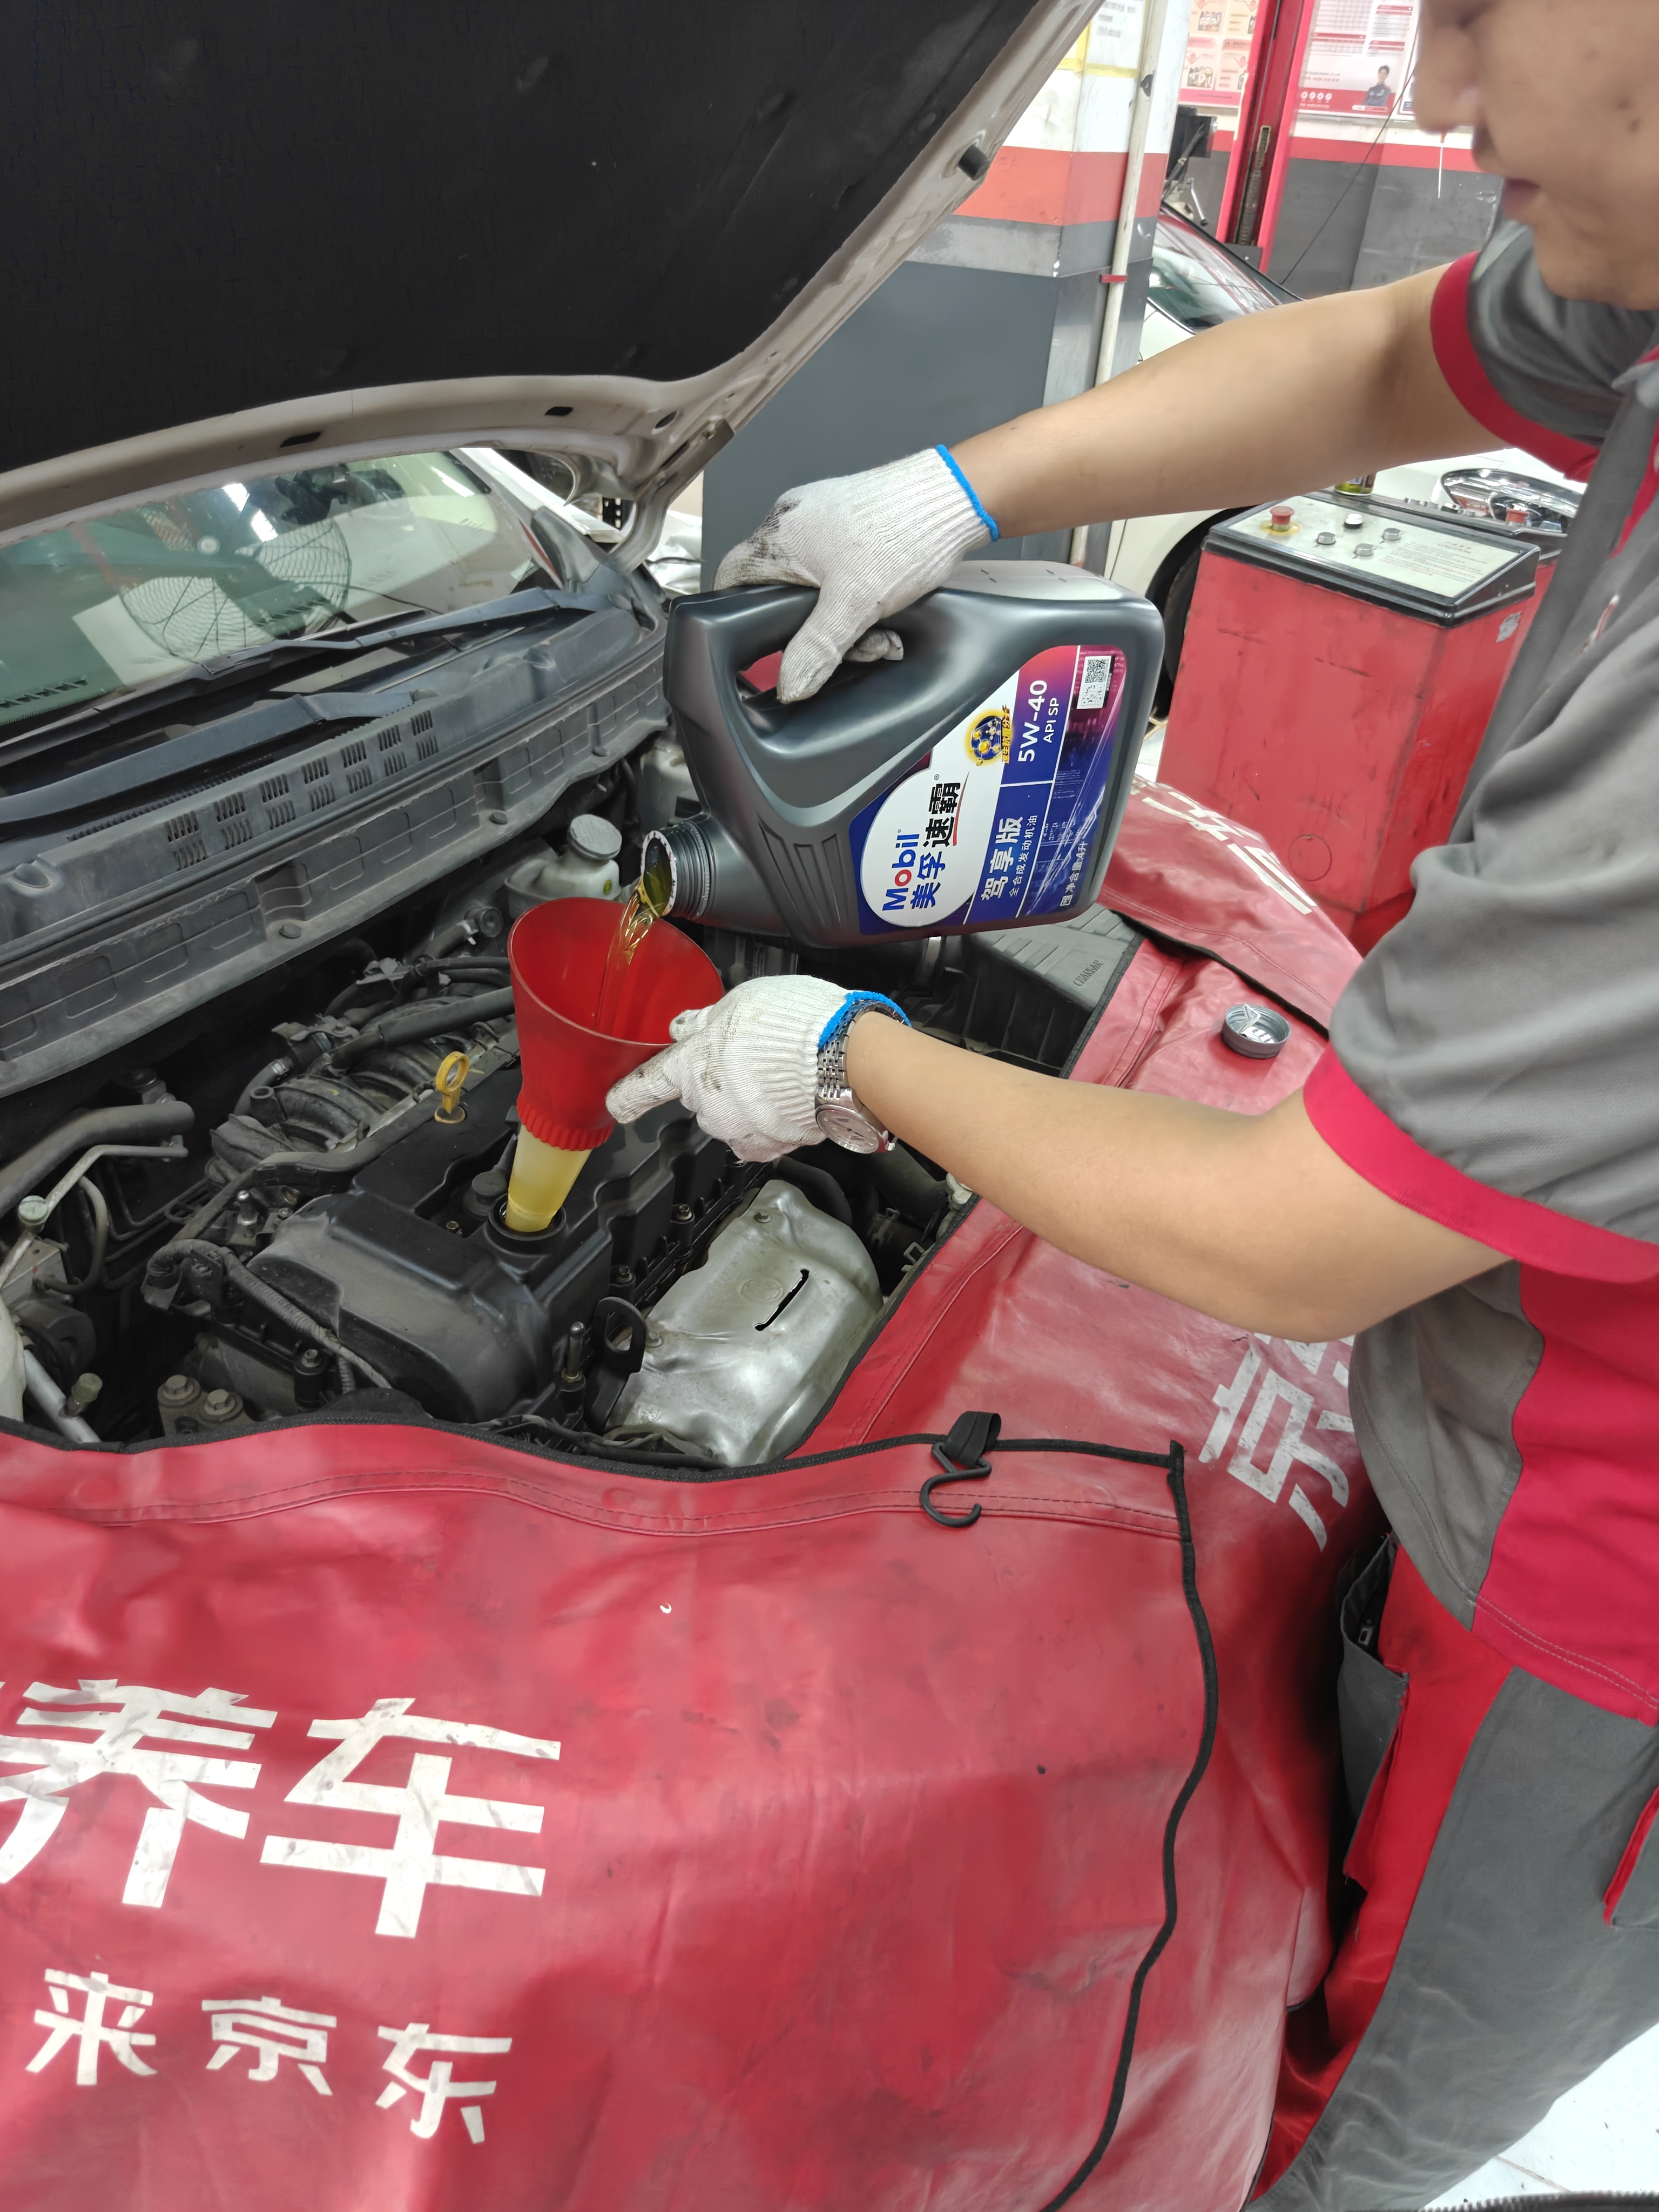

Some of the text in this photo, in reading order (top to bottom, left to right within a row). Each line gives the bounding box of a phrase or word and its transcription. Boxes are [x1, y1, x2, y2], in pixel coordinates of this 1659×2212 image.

[1017, 679, 1048, 763] 5W-40
[1043, 697, 1060, 744] API SP
[882, 834, 919, 911] Mobil
[980, 815, 1023, 901] 驾享版
[1008, 814, 1037, 898] 全合成发动机油
